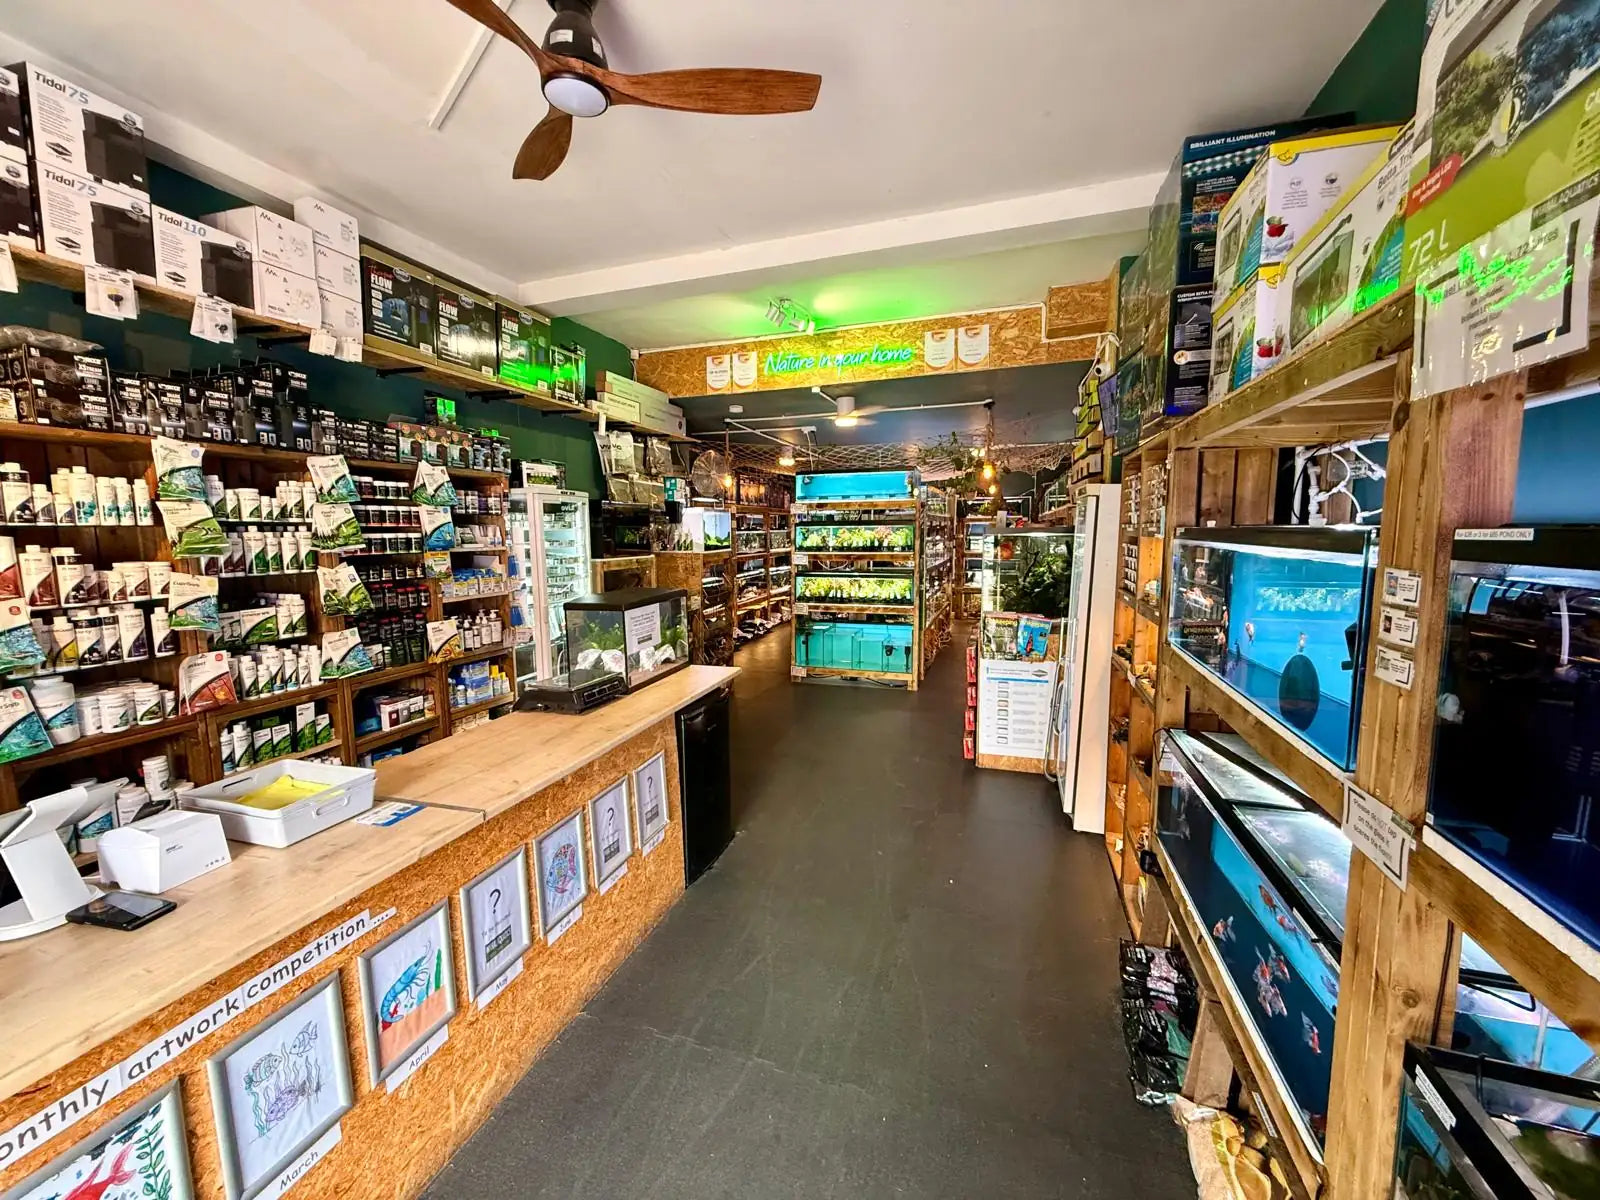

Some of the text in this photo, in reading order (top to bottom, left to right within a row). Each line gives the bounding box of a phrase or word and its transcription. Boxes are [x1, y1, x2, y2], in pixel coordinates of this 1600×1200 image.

[34, 71, 89, 105] Tidal 75
[1190, 130, 1276, 150] BRILLIANT ILLUMINATION
[44, 168, 98, 197] Tidal 75
[158, 212, 207, 237] Tidal 110
[1408, 218, 1449, 273] 72 L
[371, 273, 393, 291] FLOW
[439, 300, 458, 317] FLOW
[501, 318, 519, 333] FLOW
[764, 351, 815, 376] Nature
[819, 353, 830, 368] in
[834, 351, 868, 376] your
[871, 343, 913, 362] home
[489, 888, 501, 915] ?
[126, 996, 240, 1081] artwork
[246, 914, 367, 1001] competition
[408, 1044, 430, 1071] April
[280, 1151, 319, 1191] March
